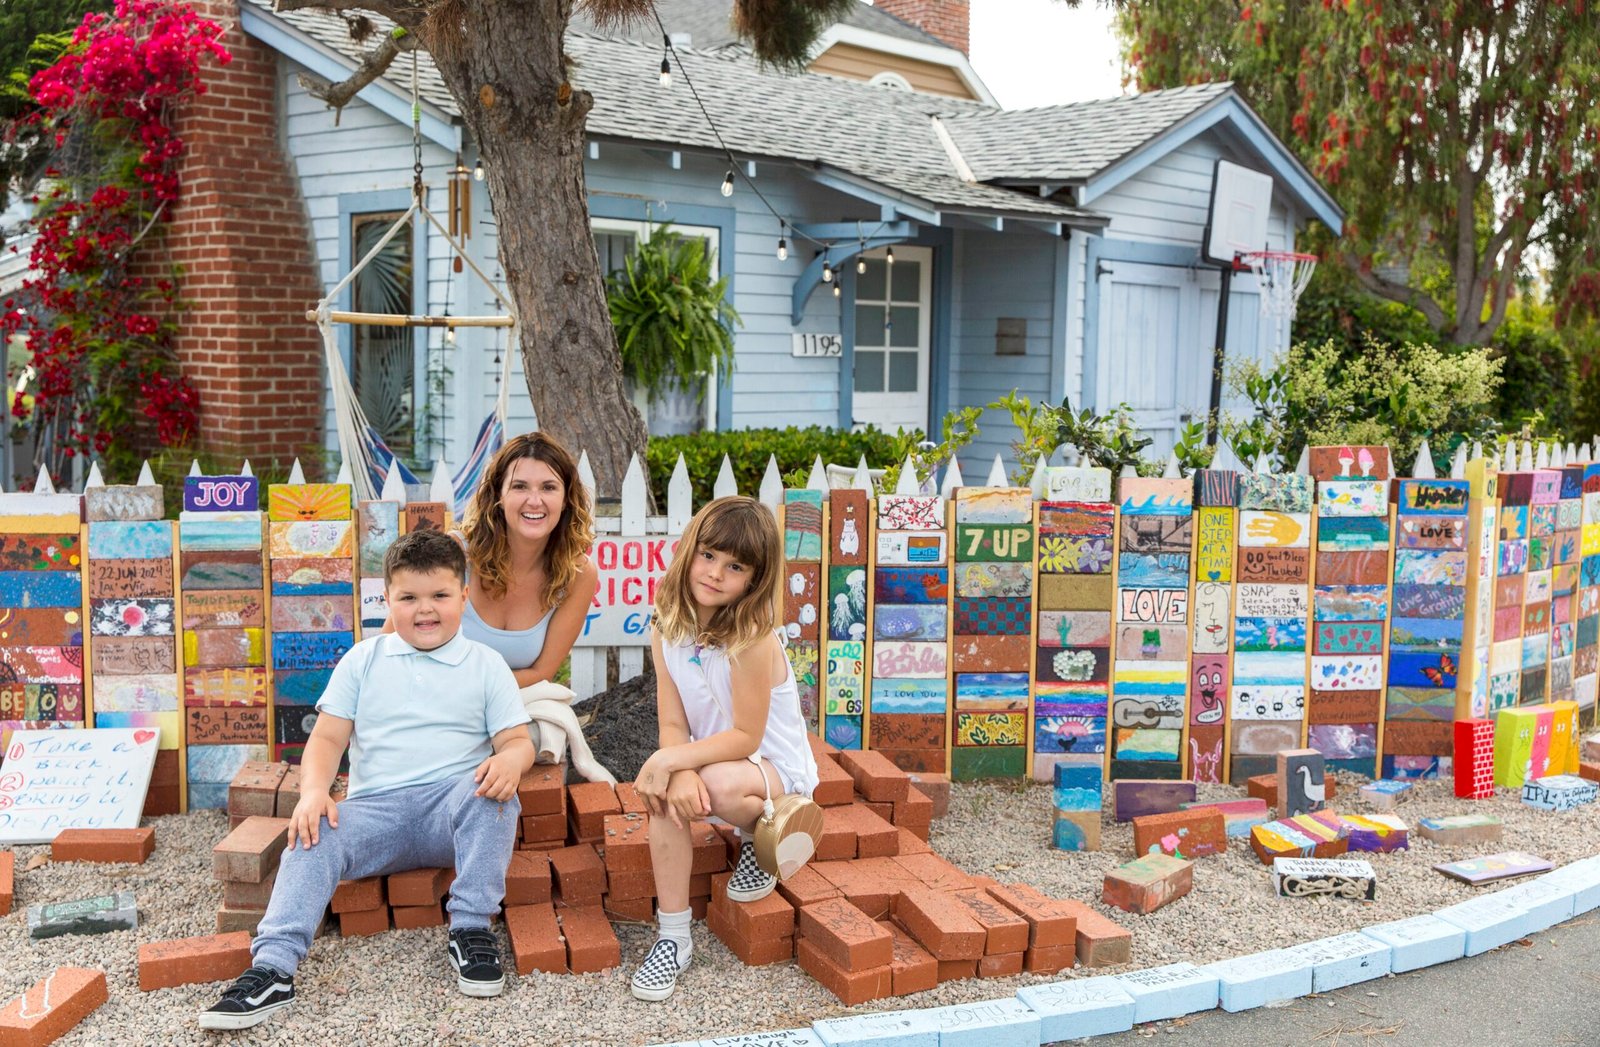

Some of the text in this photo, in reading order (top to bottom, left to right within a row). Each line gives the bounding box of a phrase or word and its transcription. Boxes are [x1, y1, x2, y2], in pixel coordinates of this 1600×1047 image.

[803, 334, 842, 355] 1195
[193, 481, 251, 507] JOY
[1203, 513, 1230, 528] ONE
[1201, 528, 1232, 541] STEP
[1420, 527, 1453, 539] LOVE
[965, 528, 1031, 558] 7 UP
[1122, 589, 1187, 623] LOVE
[894, 690, 915, 698] LOVE
[920, 690, 937, 698] YOU
